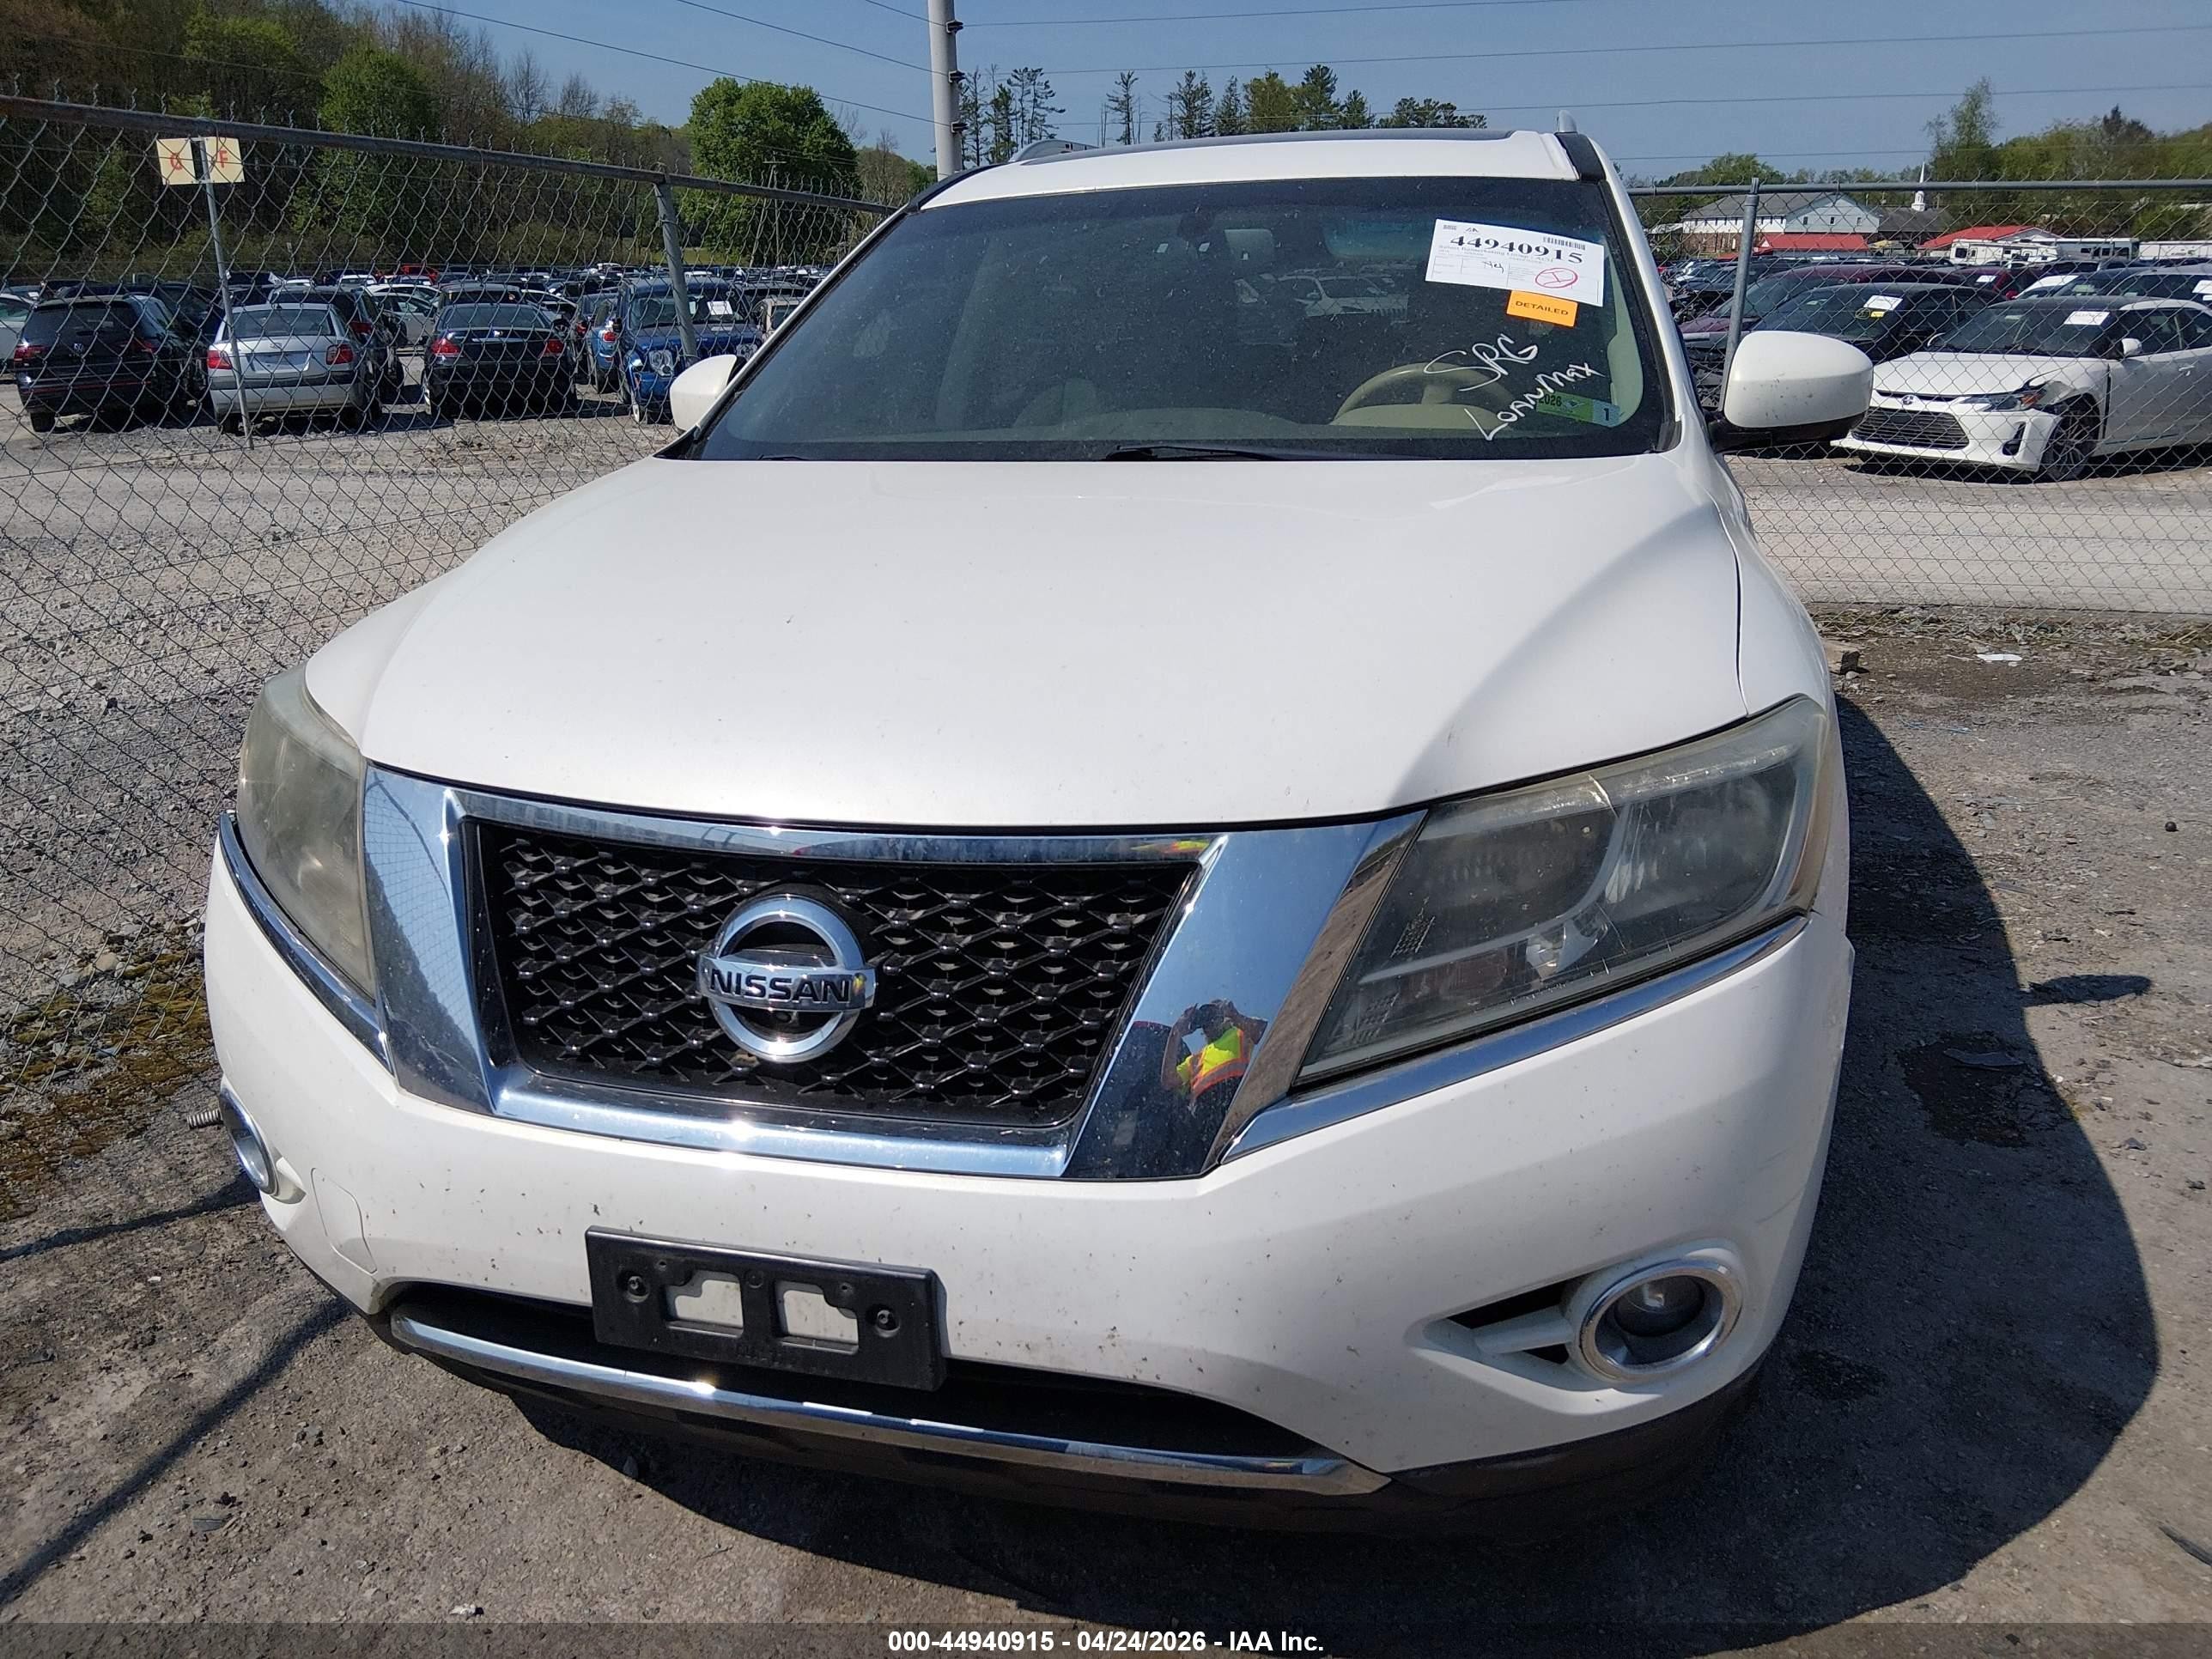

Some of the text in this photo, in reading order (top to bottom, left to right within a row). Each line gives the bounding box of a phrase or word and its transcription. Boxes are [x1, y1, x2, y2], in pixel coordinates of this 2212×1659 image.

[1449, 235, 1583, 264] 44940915
[1515, 301, 1569, 316] DETAILED
[1603, 407, 1610, 422] 1
[709, 968, 851, 1004] NISSAN
